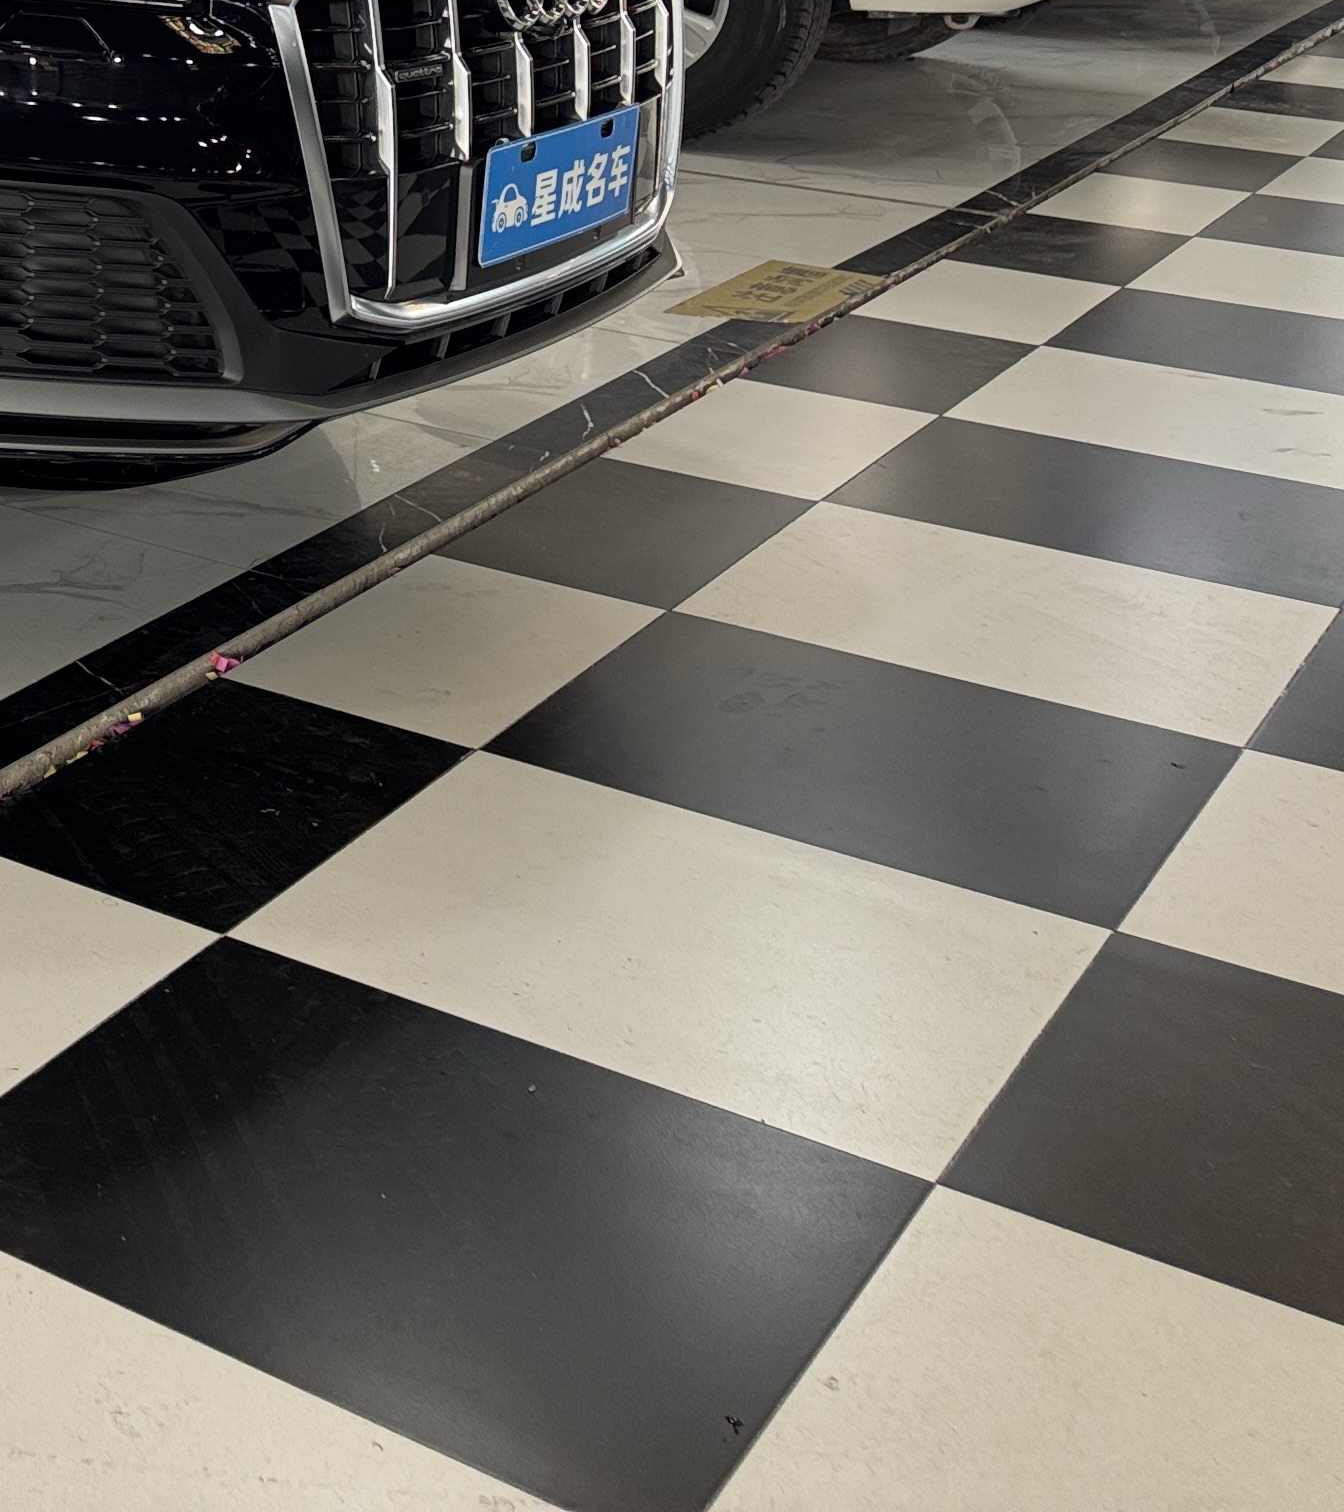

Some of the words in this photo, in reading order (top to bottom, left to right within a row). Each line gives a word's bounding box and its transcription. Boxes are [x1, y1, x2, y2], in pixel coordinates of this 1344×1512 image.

[398, 65, 443, 81] quattro
[530, 144, 631, 227] 星成名车
